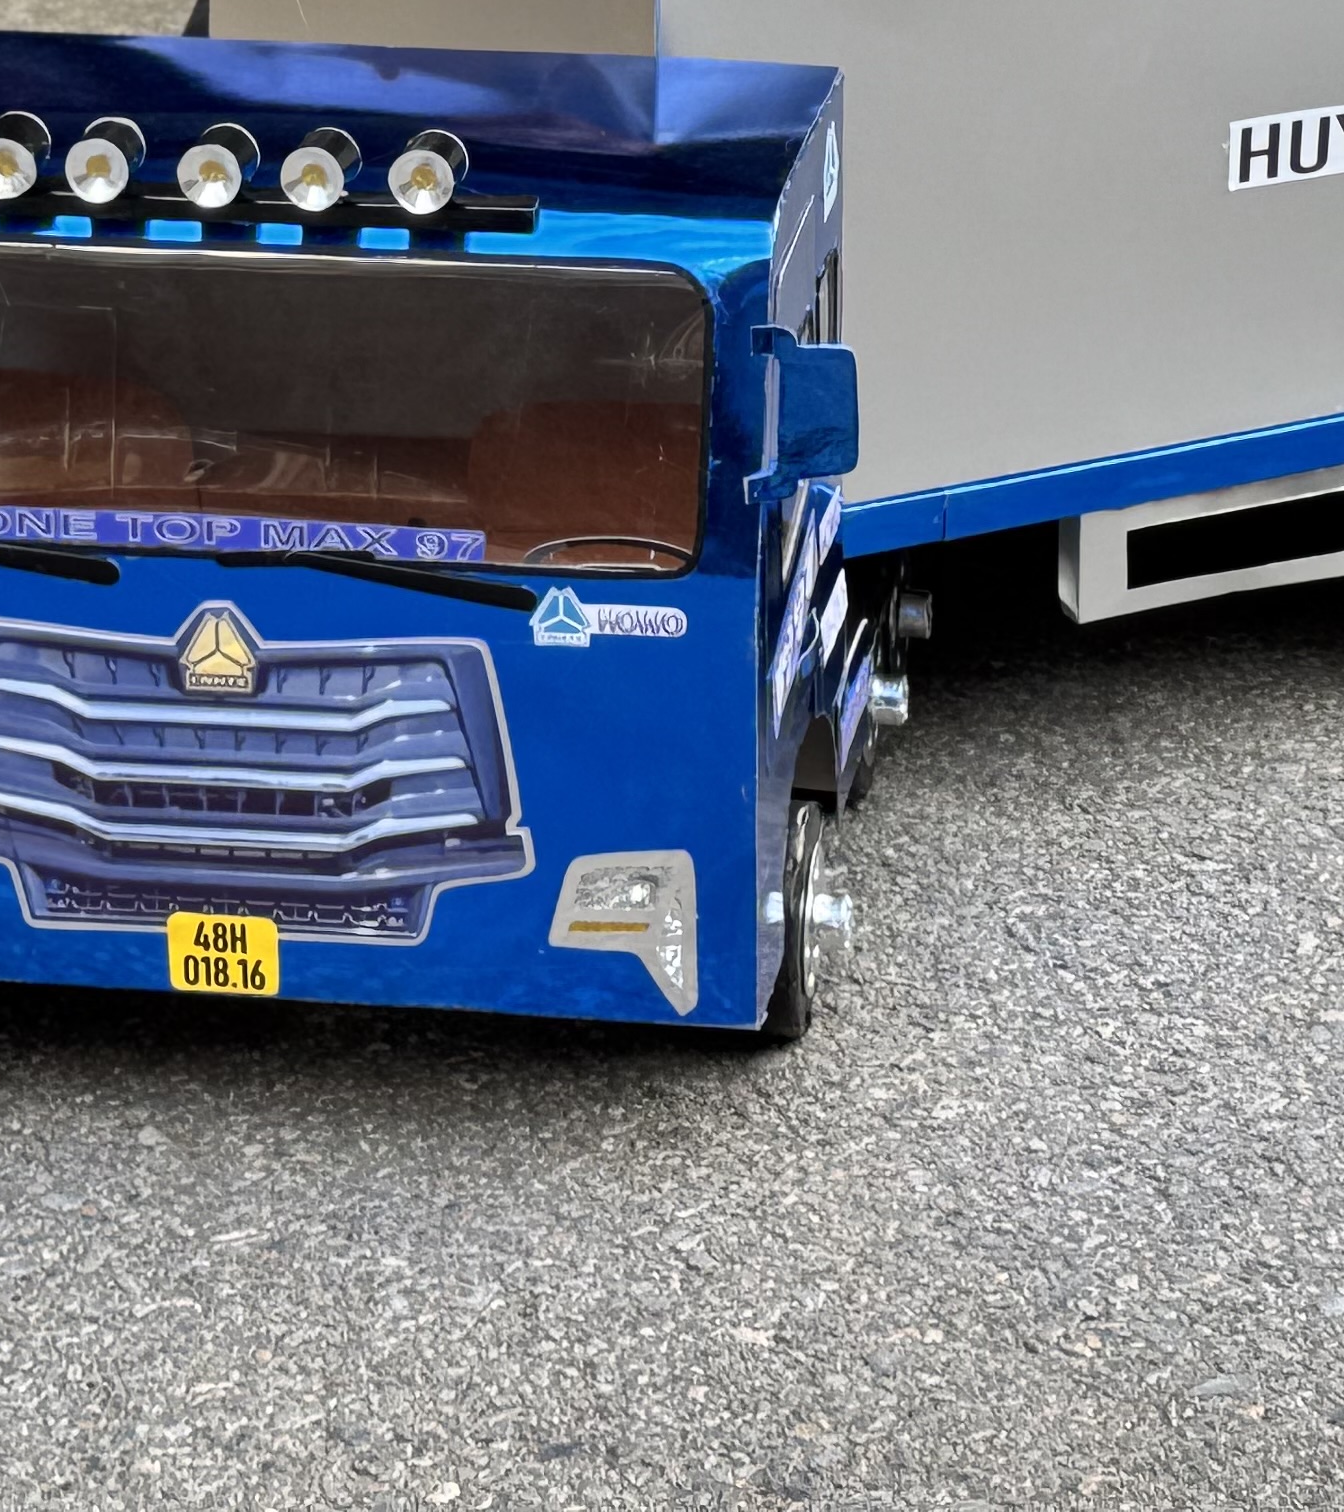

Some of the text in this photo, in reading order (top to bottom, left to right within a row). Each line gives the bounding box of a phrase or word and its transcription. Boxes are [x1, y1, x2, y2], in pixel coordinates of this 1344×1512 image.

[115, 513, 241, 545] TOP
[260, 520, 398, 556] MAX
[416, 531, 485, 562] 97
[193, 920, 248, 955] 48H
[183, 954, 266, 991] 018.16
